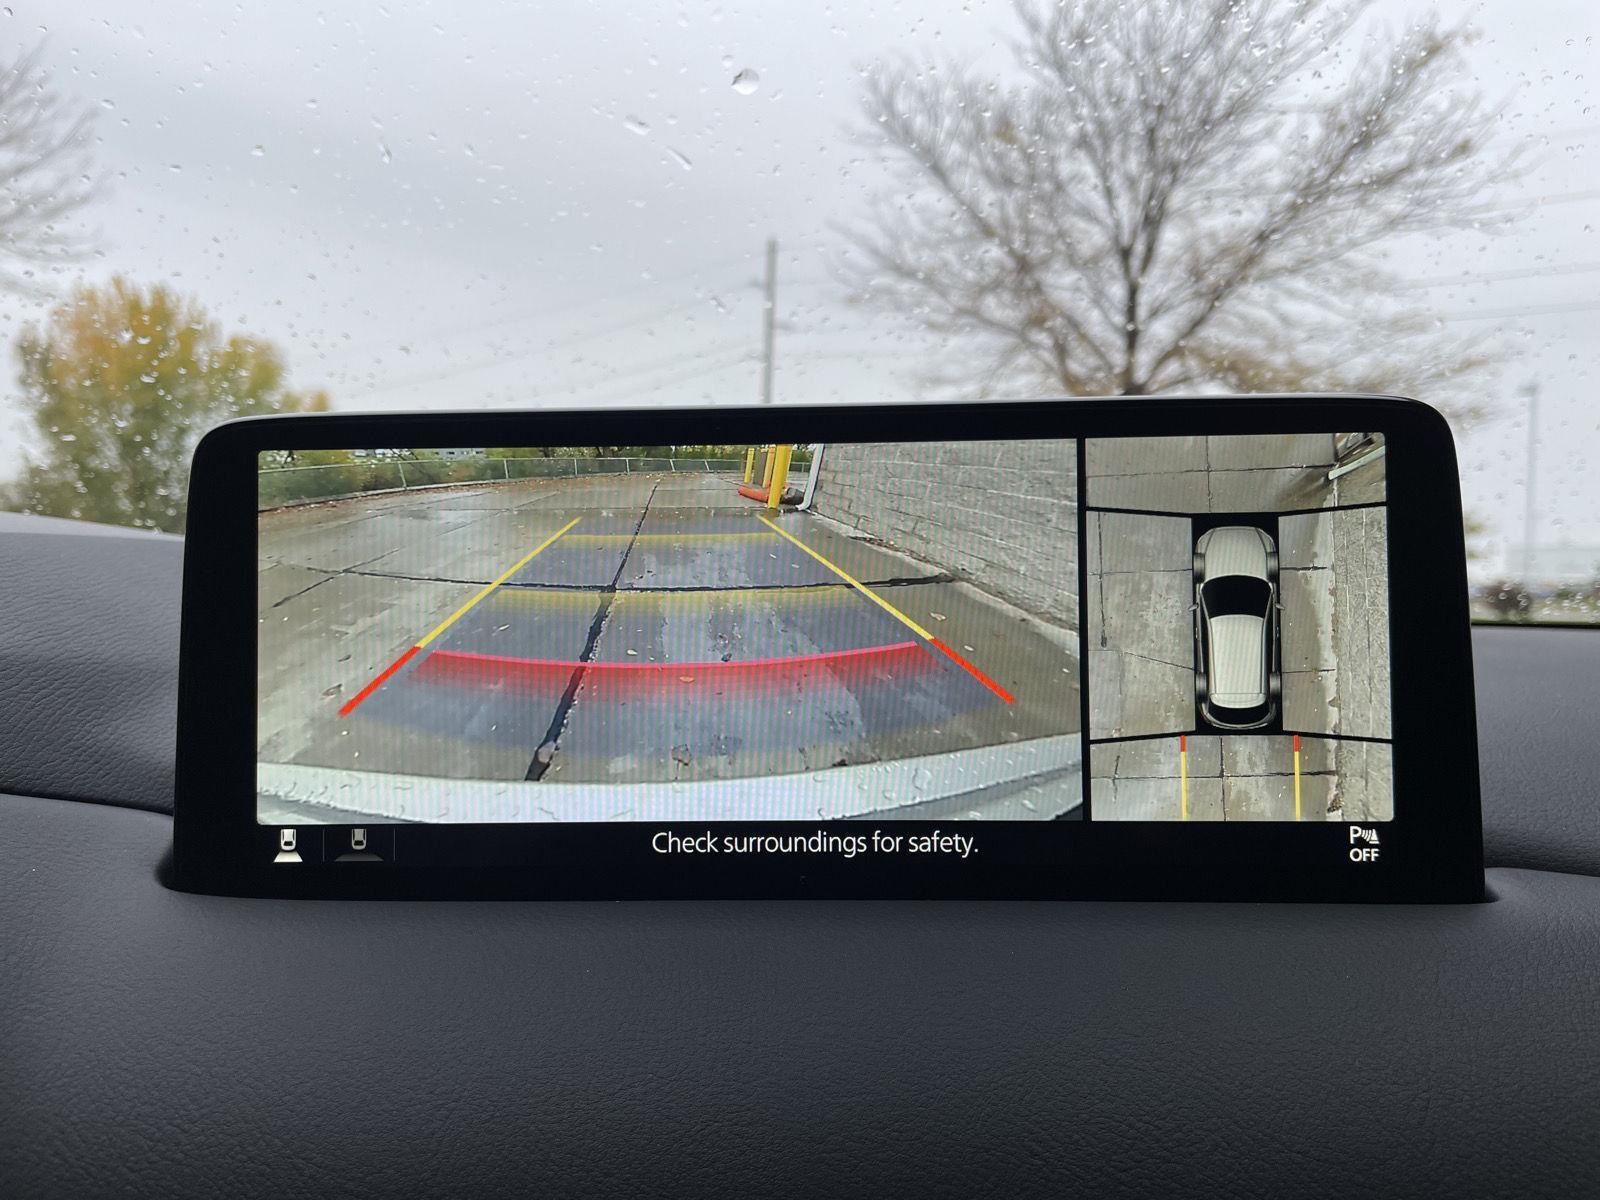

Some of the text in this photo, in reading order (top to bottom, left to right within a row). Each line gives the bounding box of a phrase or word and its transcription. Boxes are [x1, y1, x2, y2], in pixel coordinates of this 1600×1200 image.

[1349, 825, 1362, 844] P
[652, 830, 979, 859] Check surroundings for safety.
[1349, 848, 1380, 862] OFF
